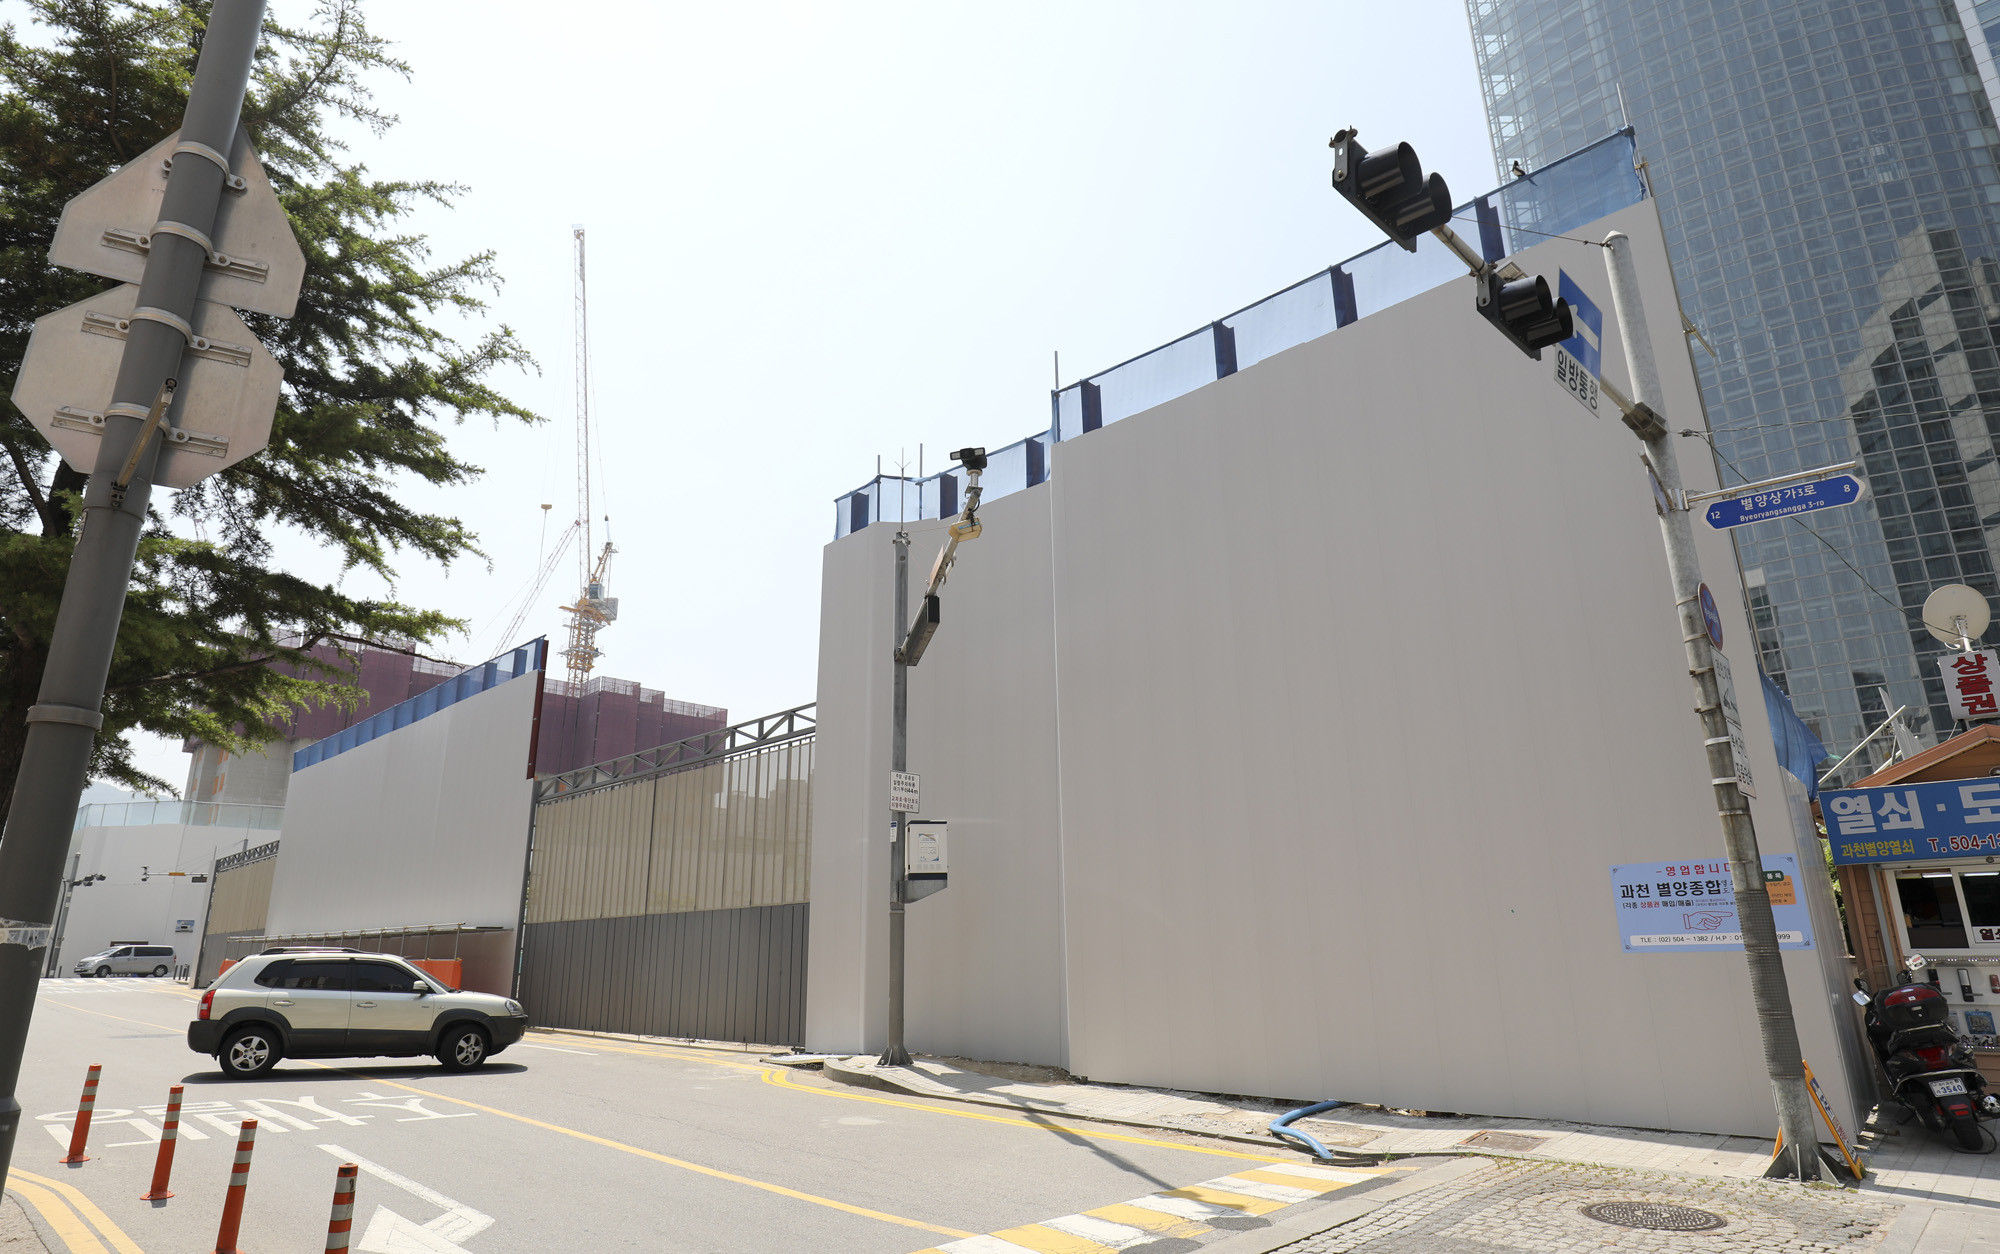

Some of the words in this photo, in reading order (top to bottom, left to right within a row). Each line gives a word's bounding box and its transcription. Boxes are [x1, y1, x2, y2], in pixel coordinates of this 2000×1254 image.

[1557, 350, 1599, 410] 일방통행
[1740, 484, 1817, 511] 별양상가3로
[1843, 484, 1851, 493] 8
[1710, 511, 1721, 520] 12
[1739, 504, 1806, 522] Byeoryangsangga
[1807, 499, 1825, 509] 3-ro
[1951, 653, 1999, 715] 상품권
[1830, 790, 1925, 836] 열쇠
[1841, 838, 1915, 858] 과천별양열쇠
[1619, 882, 1651, 899] 과천
[1656, 878, 1722, 898] 별양종합
[1640, 900, 1660, 909] 상품권
[1661, 899, 1694, 908] 매입/매출]
[1940, 1084, 1963, 1094] 3540
